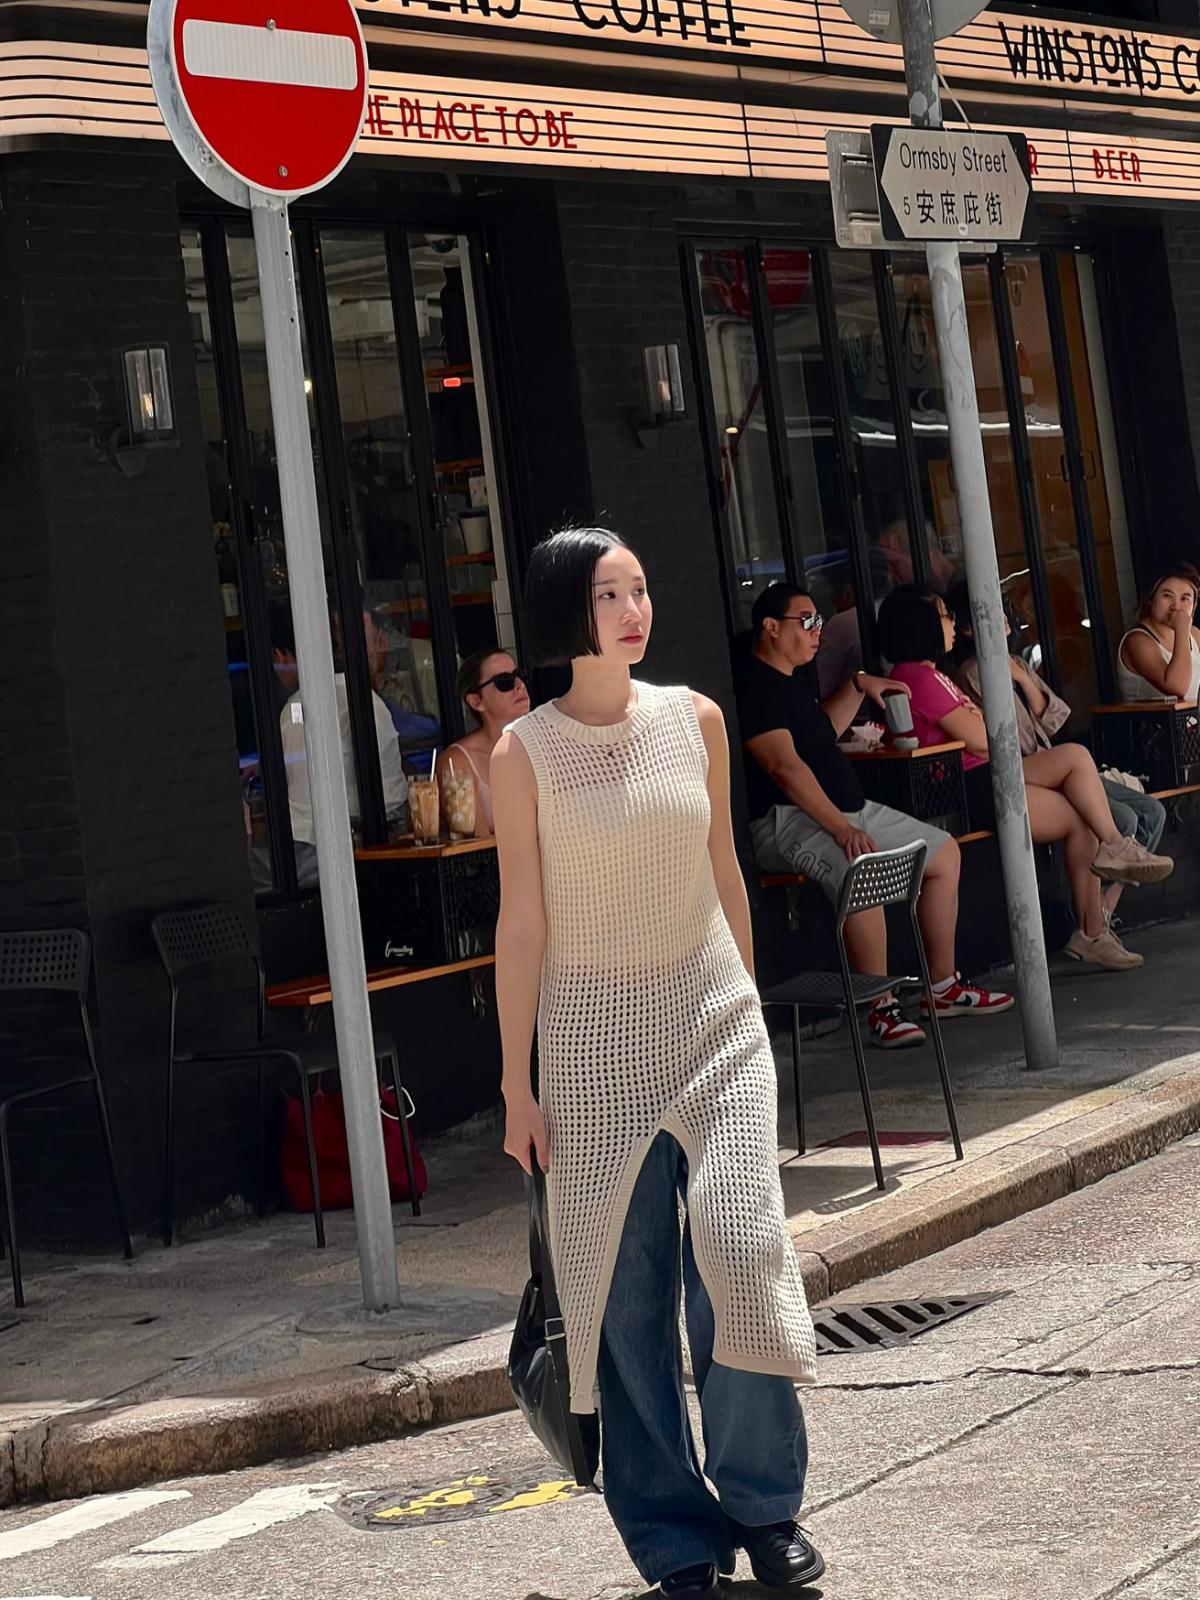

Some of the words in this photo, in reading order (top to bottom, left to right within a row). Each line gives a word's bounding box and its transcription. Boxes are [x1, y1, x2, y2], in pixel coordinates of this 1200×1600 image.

[998, 21, 1161, 90] WINSTONS
[361, 94, 393, 136] HE
[399, 97, 489, 143] PLACE
[495, 106, 539, 146] TO
[545, 109, 578, 149] BE
[899, 142, 957, 176] Ormsby
[962, 146, 1008, 173] Street
[1093, 148, 1142, 182] BEER
[903, 197, 911, 216] 5
[916, 189, 1003, 226] 安庶庇街
